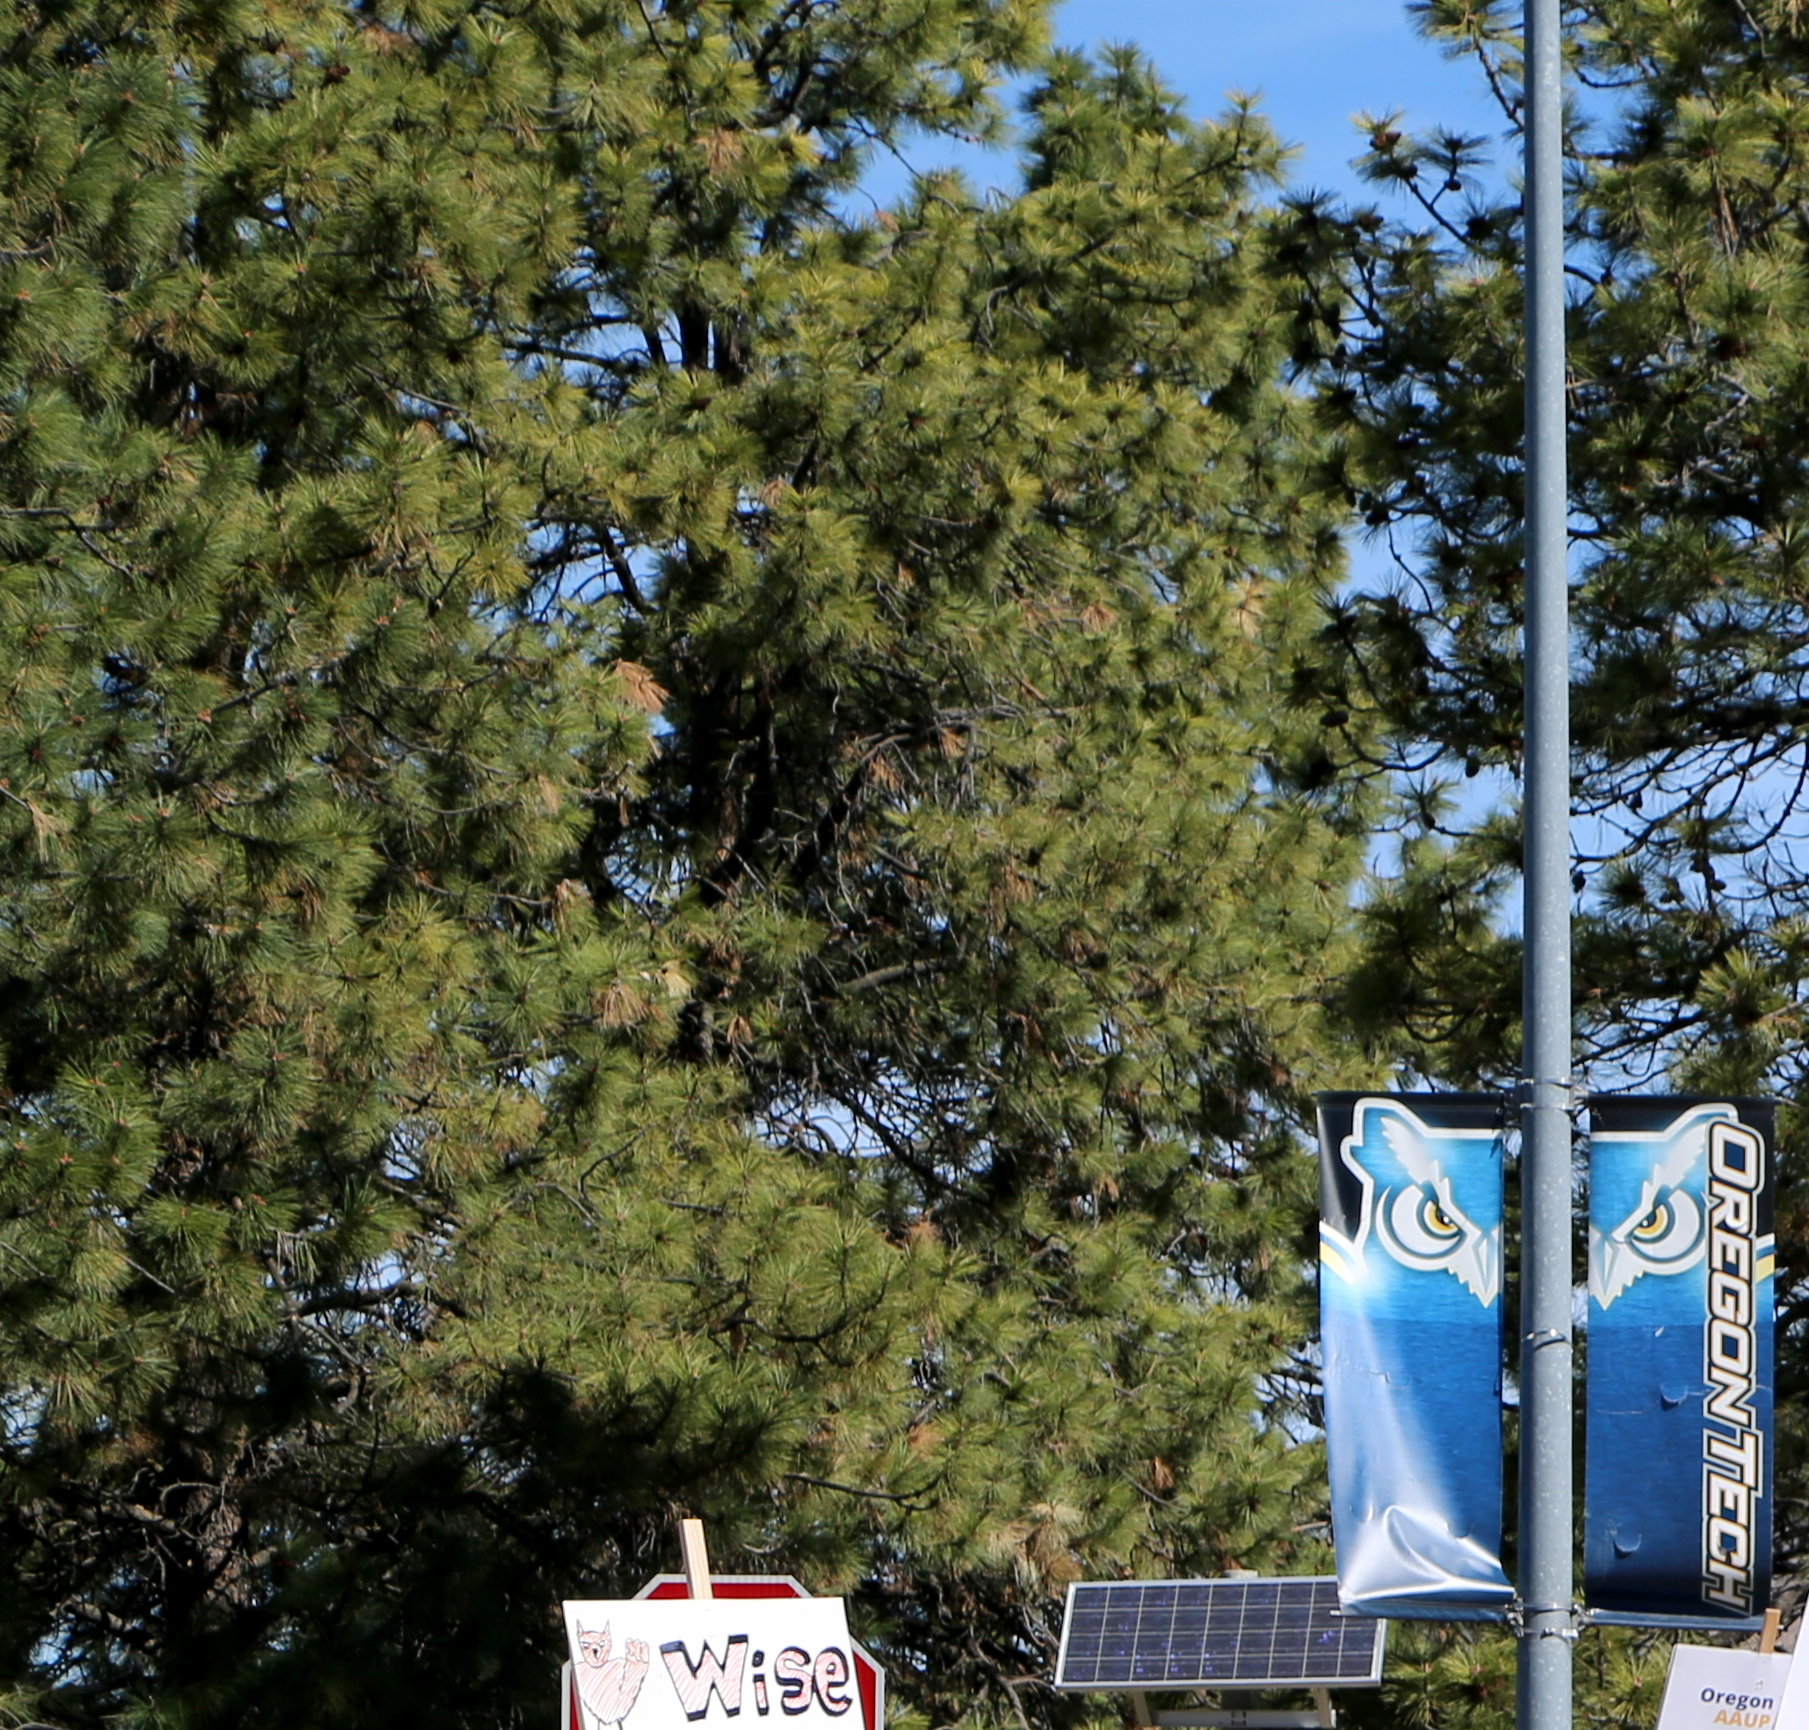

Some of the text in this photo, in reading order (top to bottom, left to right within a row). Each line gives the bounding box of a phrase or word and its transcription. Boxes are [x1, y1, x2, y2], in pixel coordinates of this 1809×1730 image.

[660, 1633, 853, 1722] Wise
[1700, 1687, 1774, 1711] Oregon
[1714, 1709, 1771, 1729] AAUP
